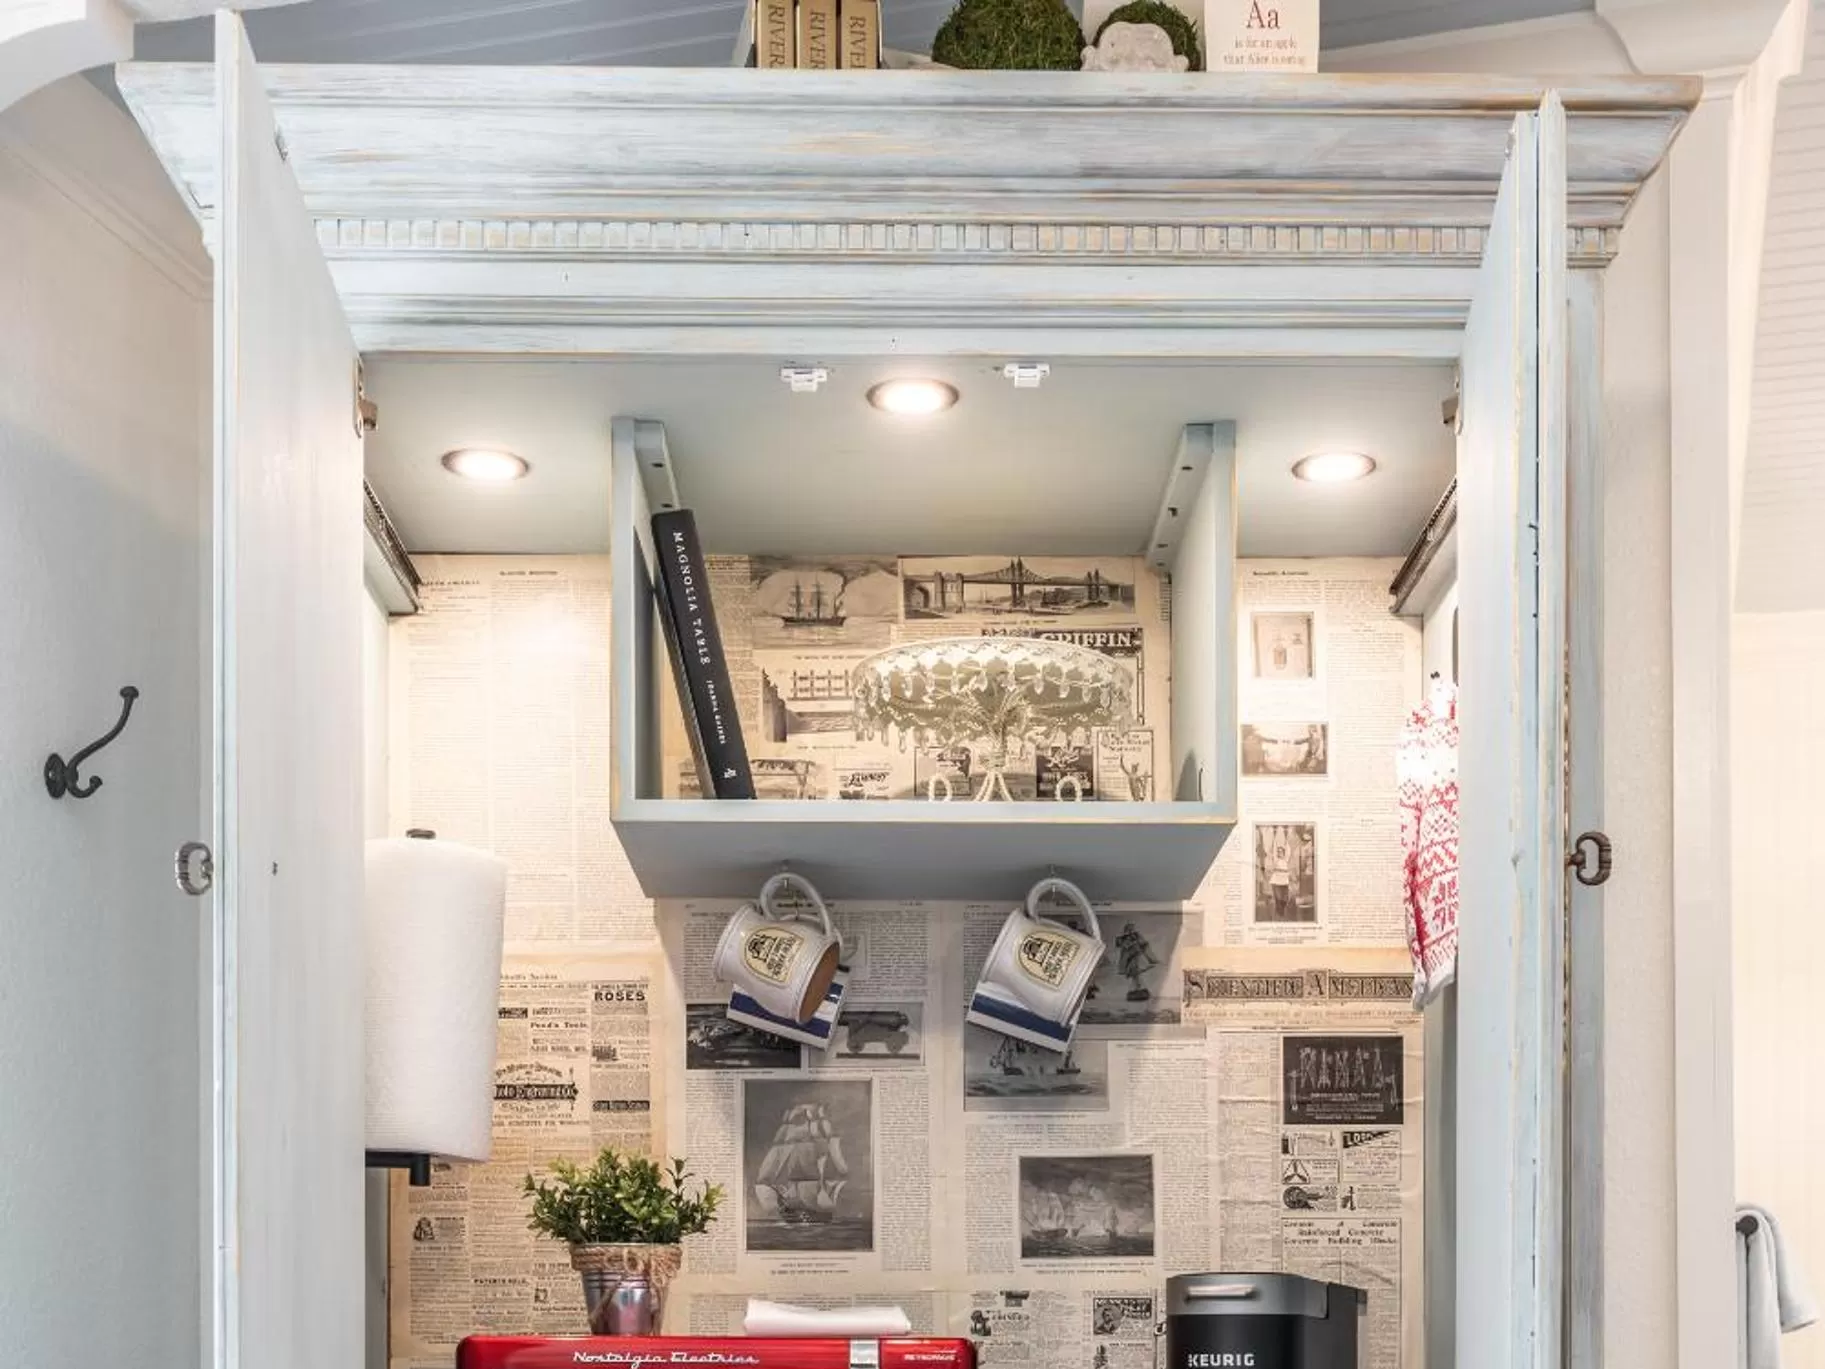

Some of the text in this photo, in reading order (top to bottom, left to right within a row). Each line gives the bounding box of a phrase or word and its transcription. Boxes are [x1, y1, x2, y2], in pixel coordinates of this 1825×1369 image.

[1246, 0, 1280, 29] Aa
[672, 531, 711, 665] MAGNOLIA TABLE
[594, 989, 646, 1002] ROSES
[573, 1351, 667, 1369] Nostalgia
[1187, 1353, 1255, 1368] KEURIG
